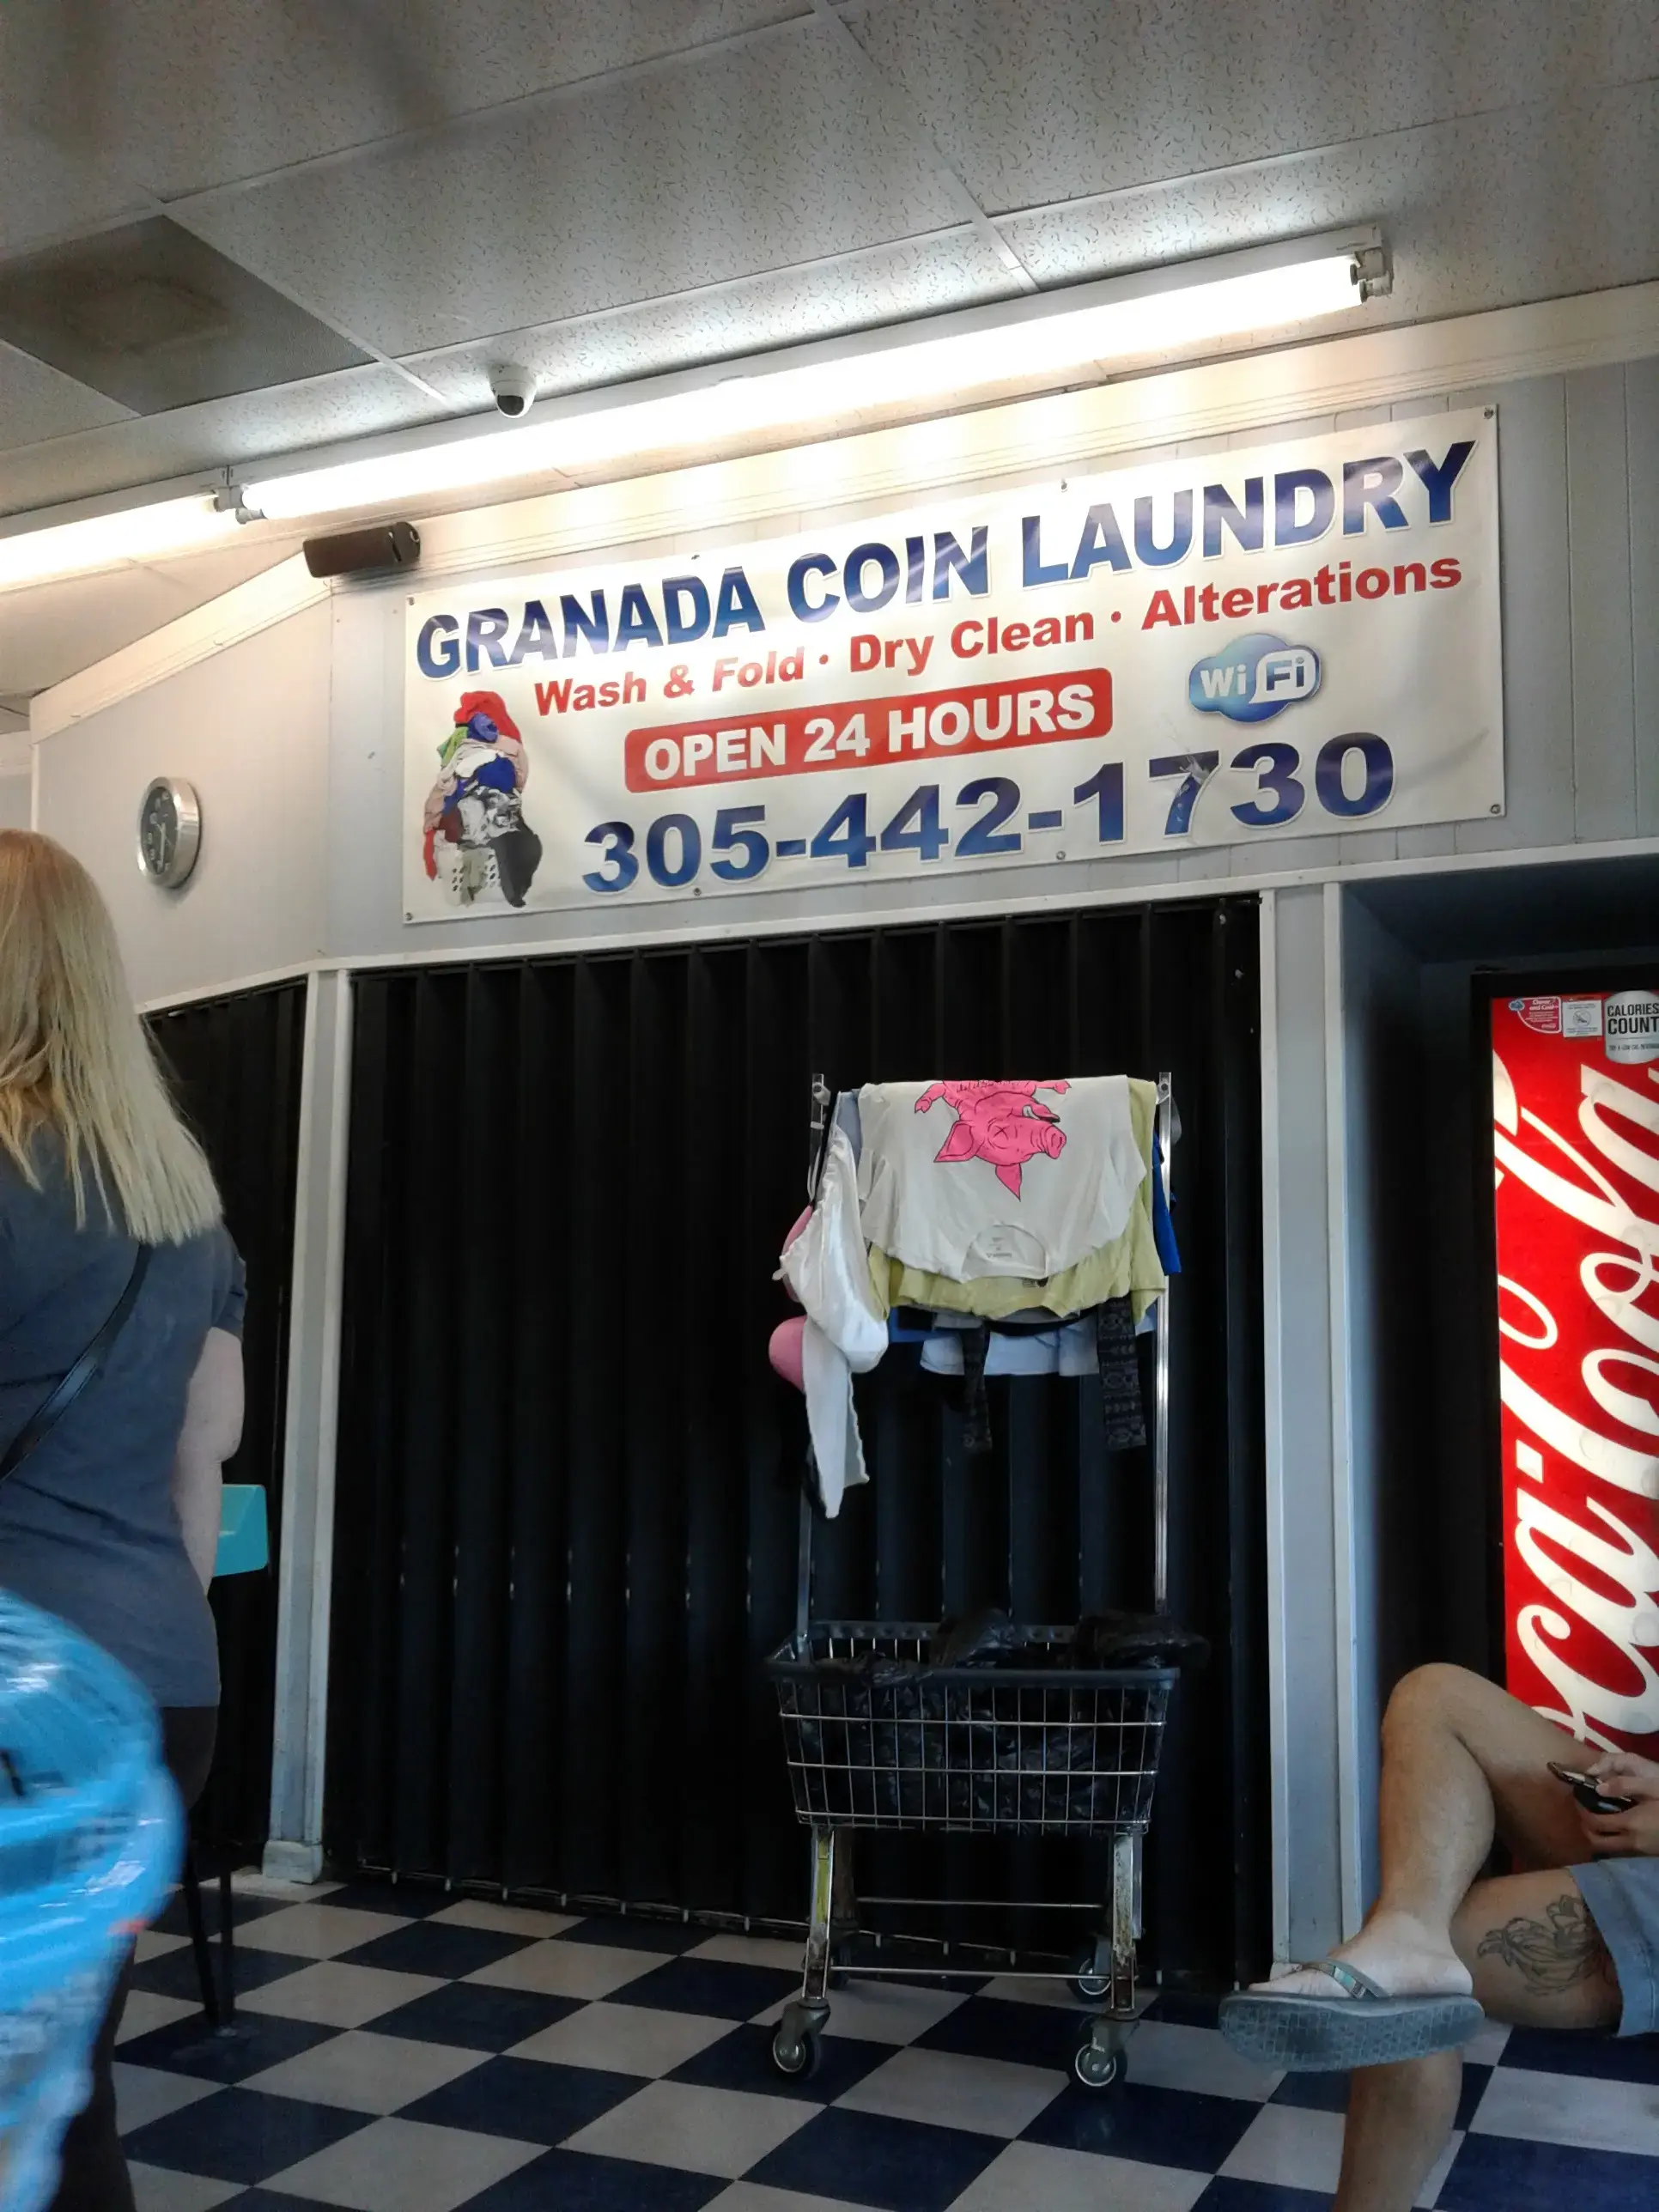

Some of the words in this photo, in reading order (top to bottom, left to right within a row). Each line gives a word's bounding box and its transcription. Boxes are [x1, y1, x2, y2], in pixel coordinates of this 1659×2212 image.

[416, 565, 767, 679] GRANADA
[787, 525, 990, 623] COIN
[1021, 440, 1478, 589] LAUNDRY
[533, 672, 647, 717] Wash
[663, 664, 694, 698] &
[711, 646, 805, 693] Fold
[848, 633, 933, 677] Dry
[950, 611, 1096, 659] Clean
[1141, 556, 1463, 631] Alterations
[643, 722, 787, 781] OPEN
[803, 717, 871, 763] 24
[887, 683, 1097, 753] HOURS
[581, 732, 1395, 895] 305-442-1730
[1607, 1002, 1659, 1018] CALORIES
[1607, 1016, 1659, 1035] COUNT
